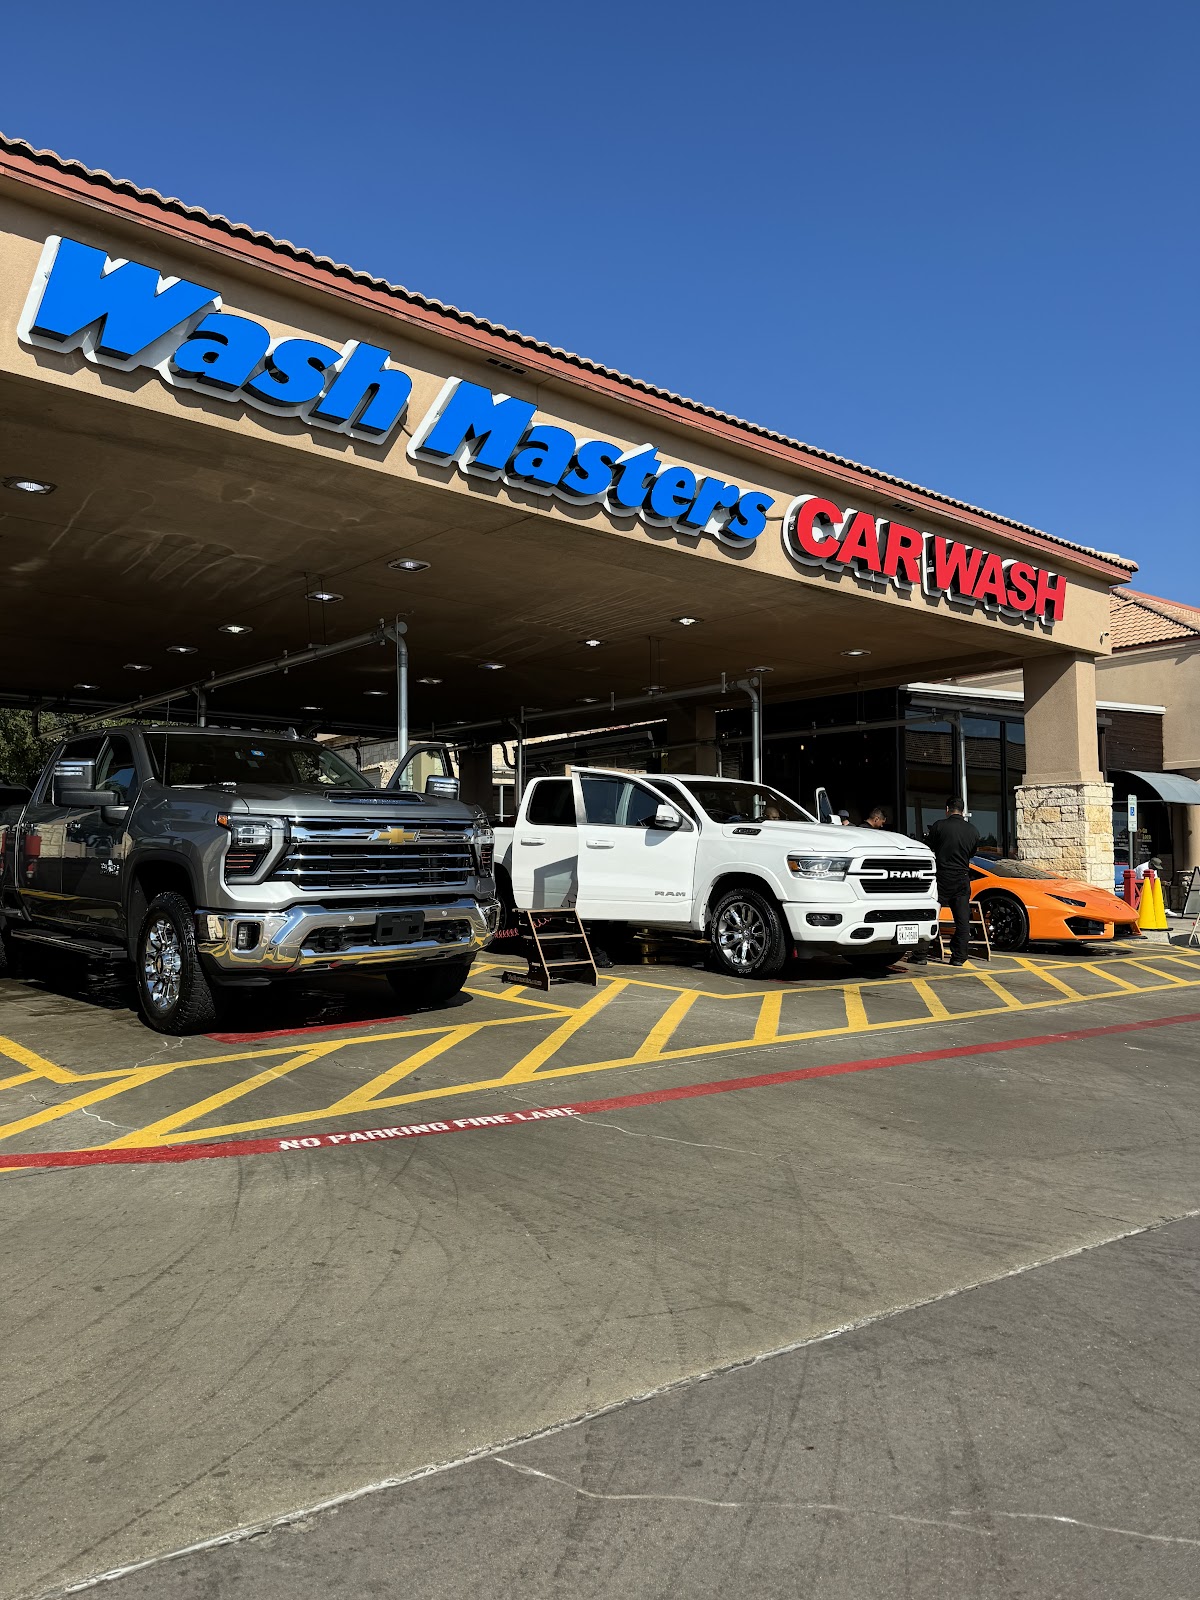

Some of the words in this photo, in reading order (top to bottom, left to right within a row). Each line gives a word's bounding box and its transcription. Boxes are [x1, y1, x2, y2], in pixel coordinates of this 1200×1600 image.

[26, 236, 413, 440] Wash
[412, 380, 776, 542] Masters
[790, 497, 924, 585] CAR
[932, 535, 1068, 622] WASH
[889, 870, 921, 879] RAM
[279, 1136, 322, 1151] NO
[328, 1121, 451, 1145] PARKING
[452, 1113, 513, 1129] FIRE
[512, 1106, 582, 1121] LANE
